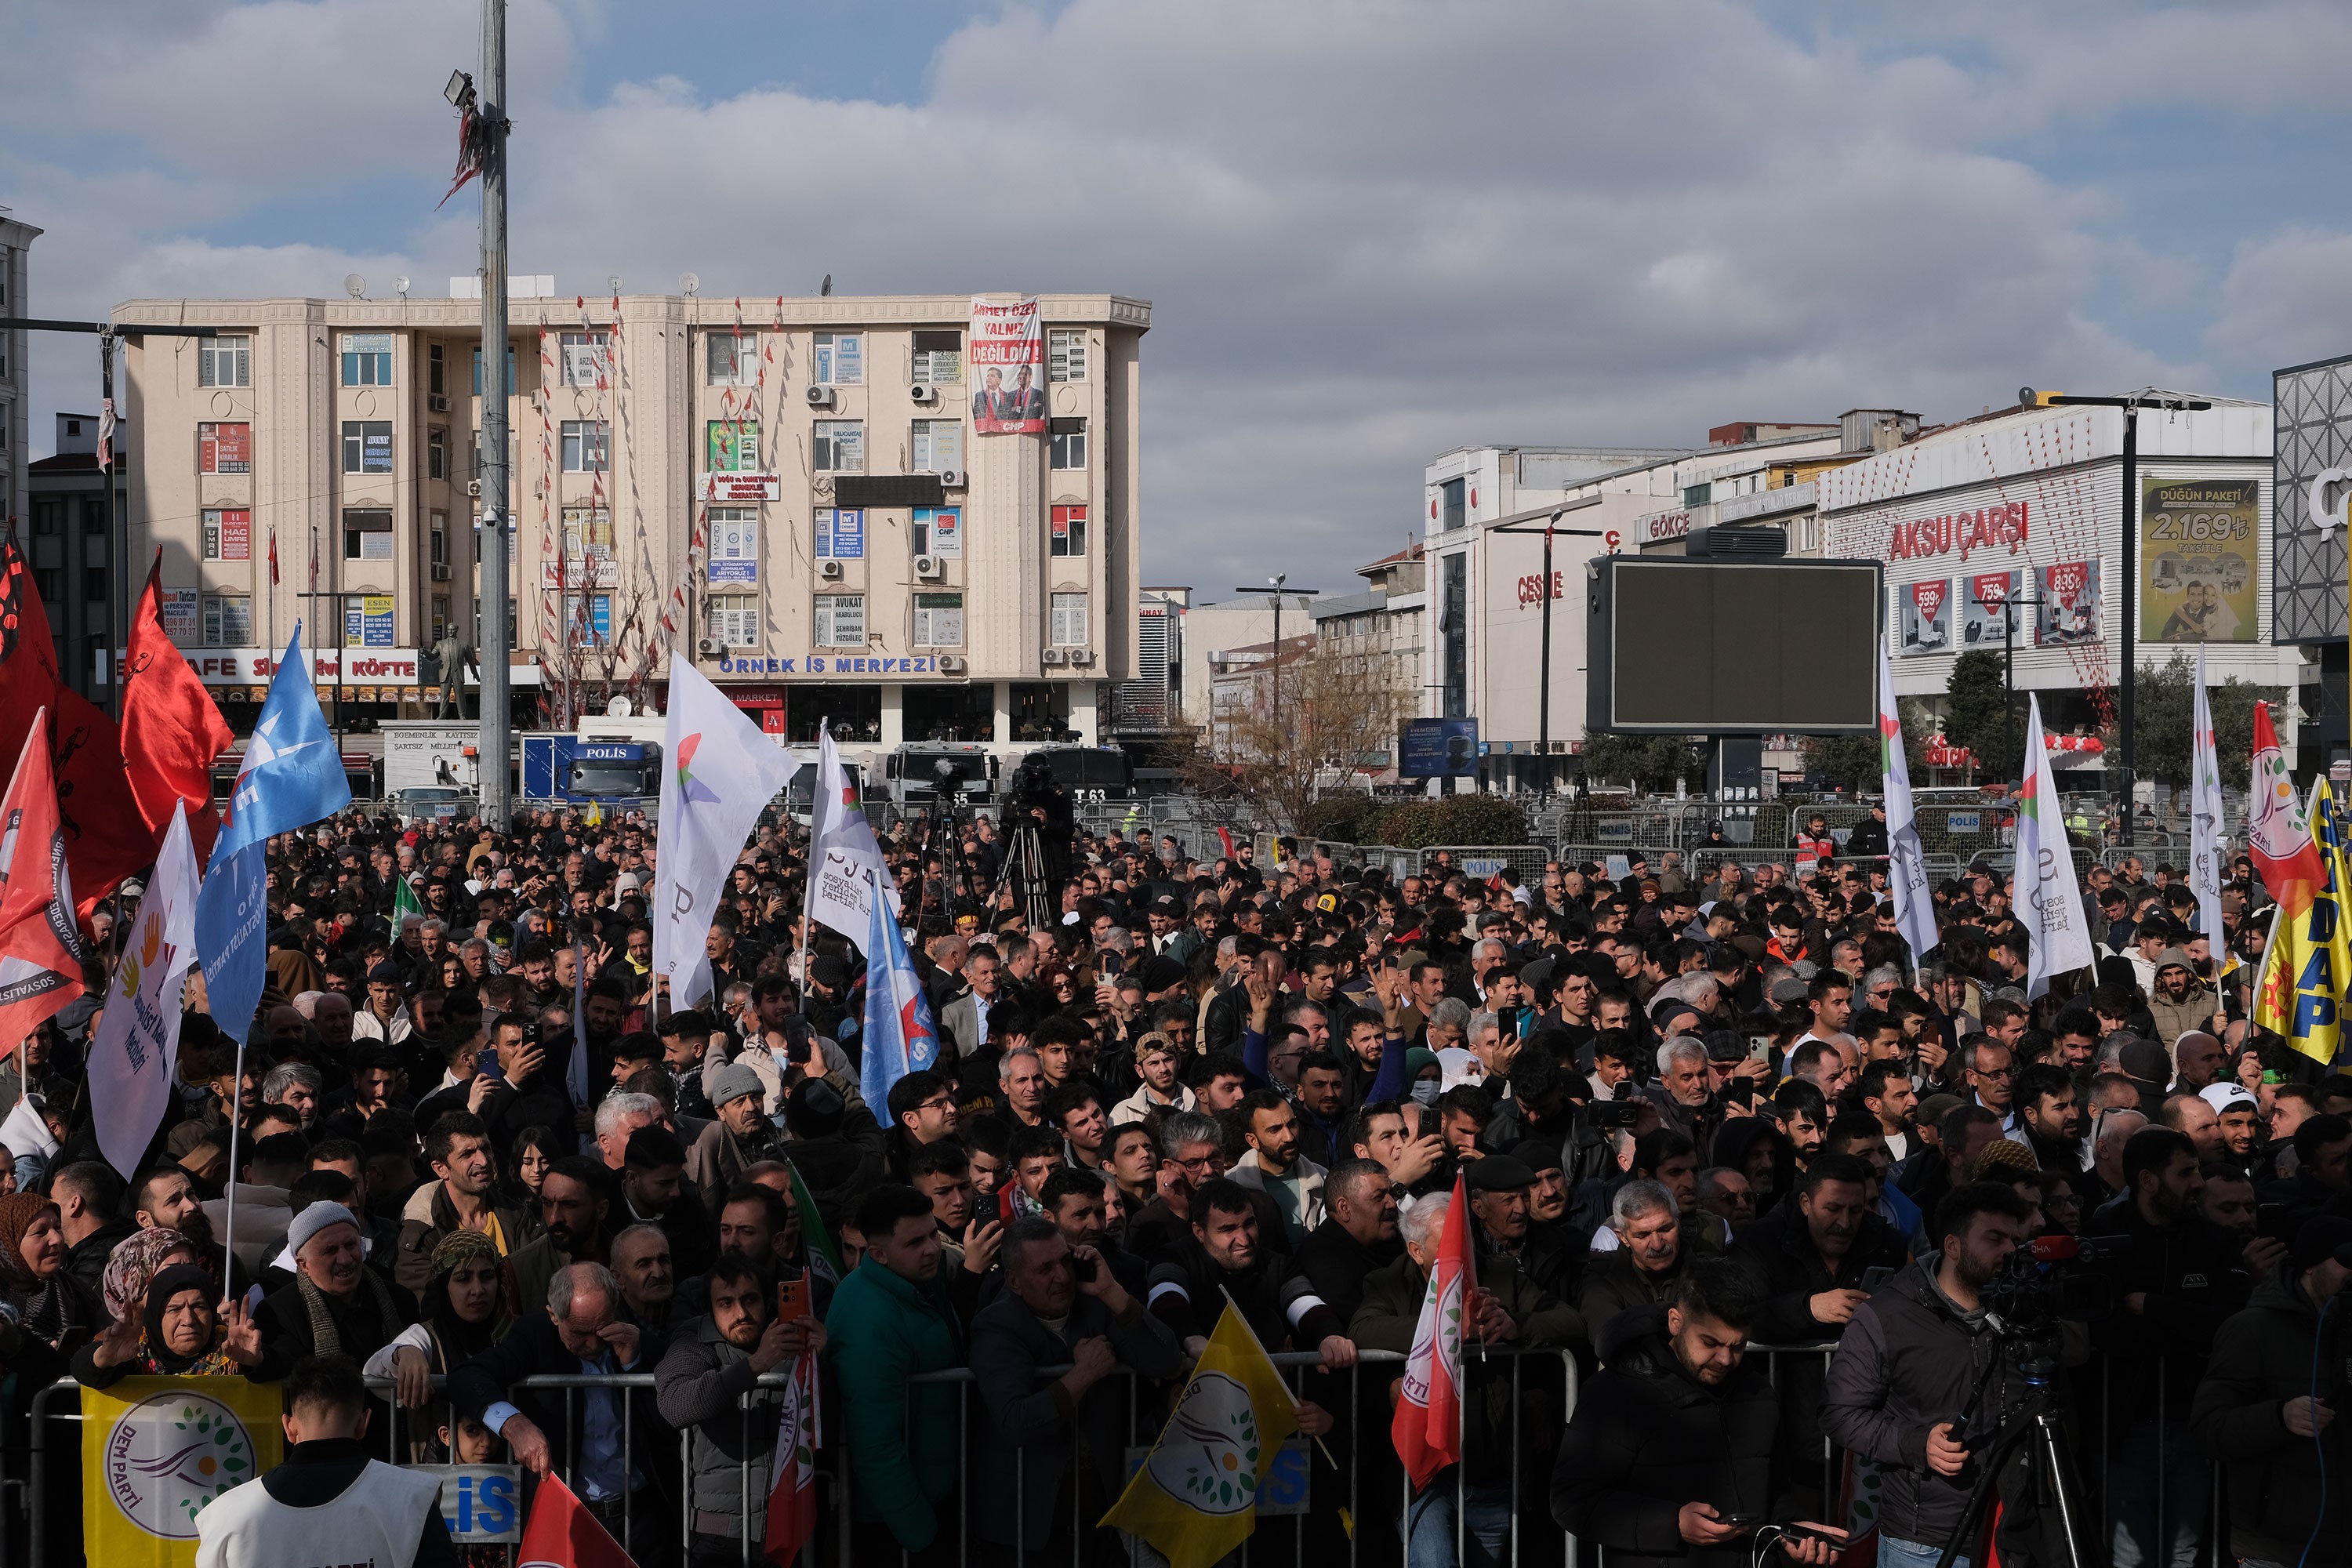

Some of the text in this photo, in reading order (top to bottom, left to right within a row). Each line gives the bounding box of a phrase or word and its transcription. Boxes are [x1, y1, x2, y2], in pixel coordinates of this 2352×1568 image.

[985, 322, 1024, 336] YALNIZ
[973, 343, 1030, 362] DEĞİLDİR
[579, 357, 593, 365] ARZU
[579, 369, 592, 378] KAYA
[1003, 422, 1025, 431] CHP
[718, 474, 734, 483] DOĞU
[2161, 488, 2241, 501] DÜĞÜN PAKETİ
[1650, 514, 1690, 539] GÖKÇE
[1890, 502, 2029, 561] AKSU ÇARŞI
[2177, 543, 2223, 554] TAKSİTLE
[835, 597, 862, 608] AVUKAT
[352, 656, 416, 677] KÖFTE
[720, 655, 795, 673] ÖRNEK
[836, 655, 935, 673] MERKEZİ
[737, 694, 778, 702] MARKET
[586, 747, 627, 757] POLİS
[1089, 789, 1105, 803] 63
[1949, 815, 1979, 826] POLİS
[112, 1425, 143, 1511] DEM PARTİ
